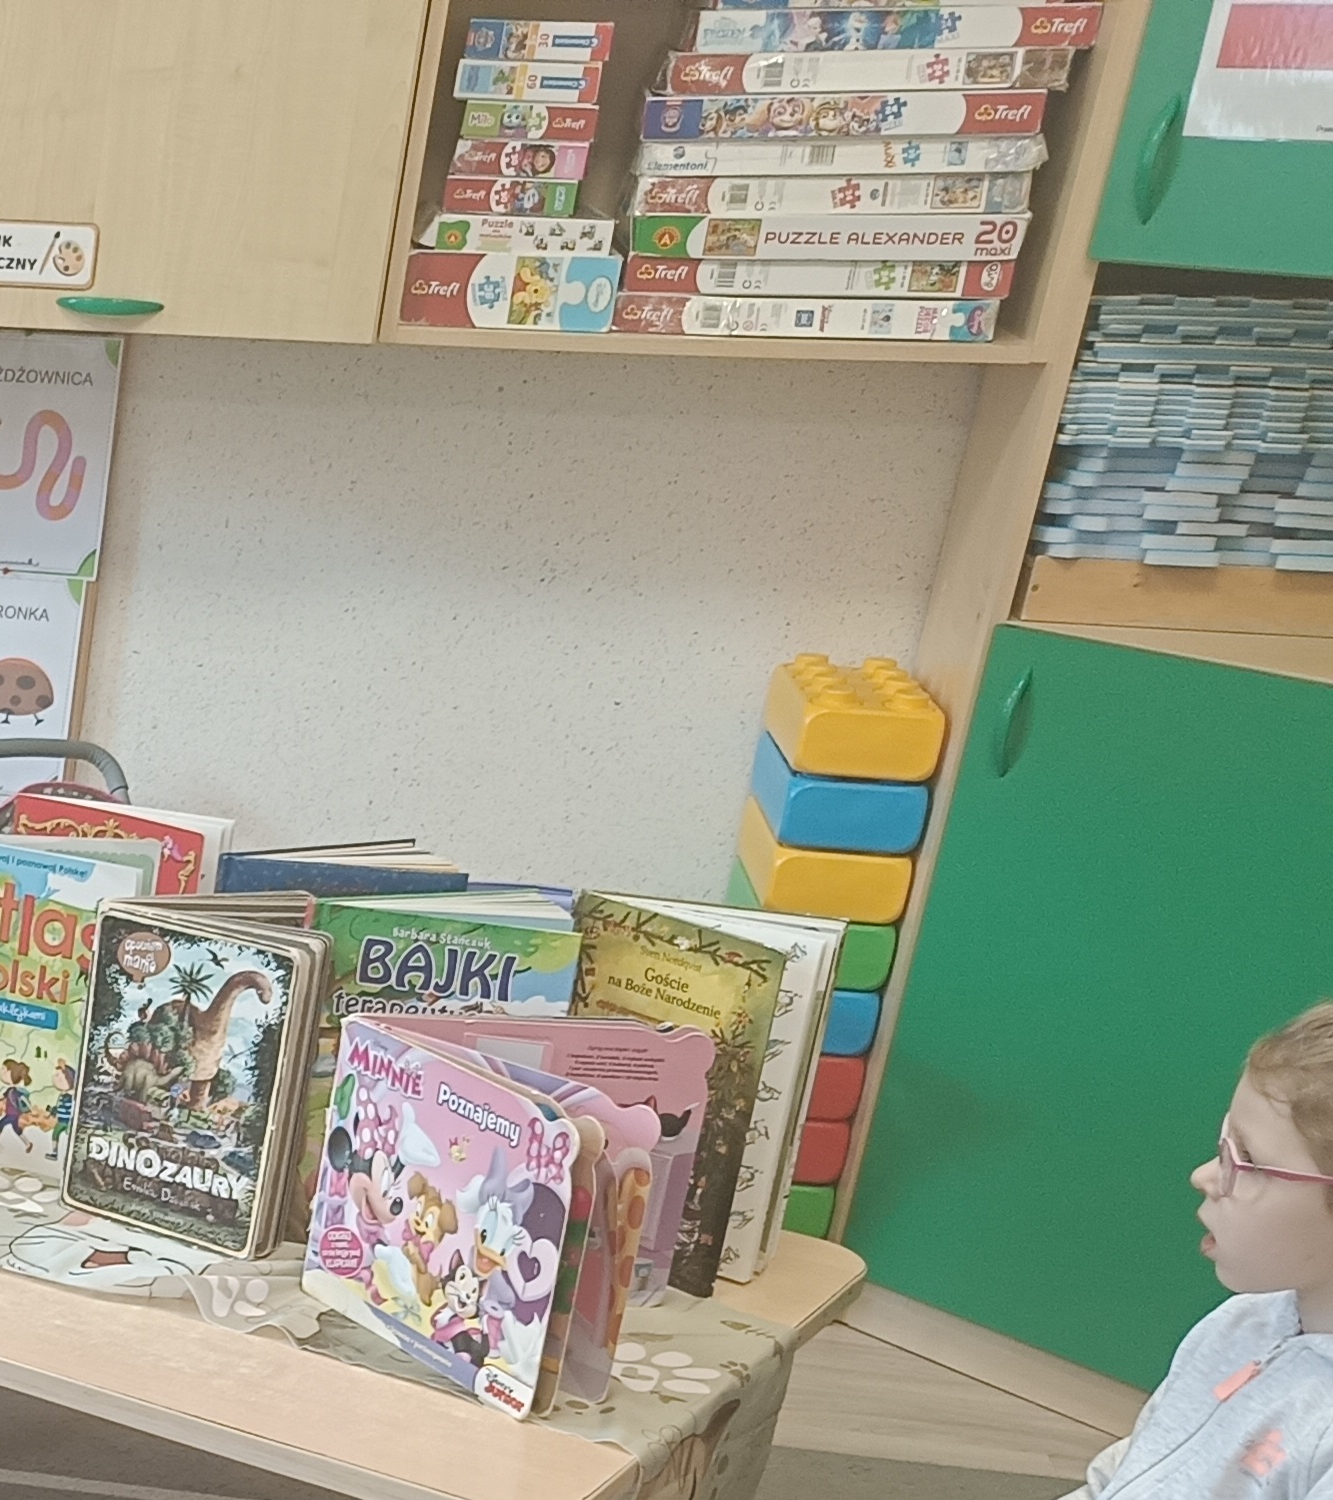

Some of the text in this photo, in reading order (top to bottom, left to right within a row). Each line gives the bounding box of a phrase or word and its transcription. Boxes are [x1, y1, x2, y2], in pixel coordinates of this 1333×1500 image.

[1051, 17, 1088, 33] Trefl
[995, 105, 1031, 121] Trefl
[482, 218, 514, 230] Puzzle
[974, 220, 1018, 245] 20
[765, 232, 964, 245] PUZZLE ALEXANDER
[974, 244, 1012, 256] maxi
[655, 265, 688, 282] Trefl
[428, 281, 460, 298] Trefl
[641, 306, 674, 323] Trefl
[392, 927, 436, 942] Barbara
[357, 935, 518, 1002] BAJKI
[644, 967, 689, 993] Goście
[608, 975, 721, 1020] na Boże Narodzenie
[346, 1037, 424, 1100] MINNIE
[437, 1082, 522, 1148] Poznajemy
[88, 1136, 251, 1201] DINOZAURY
